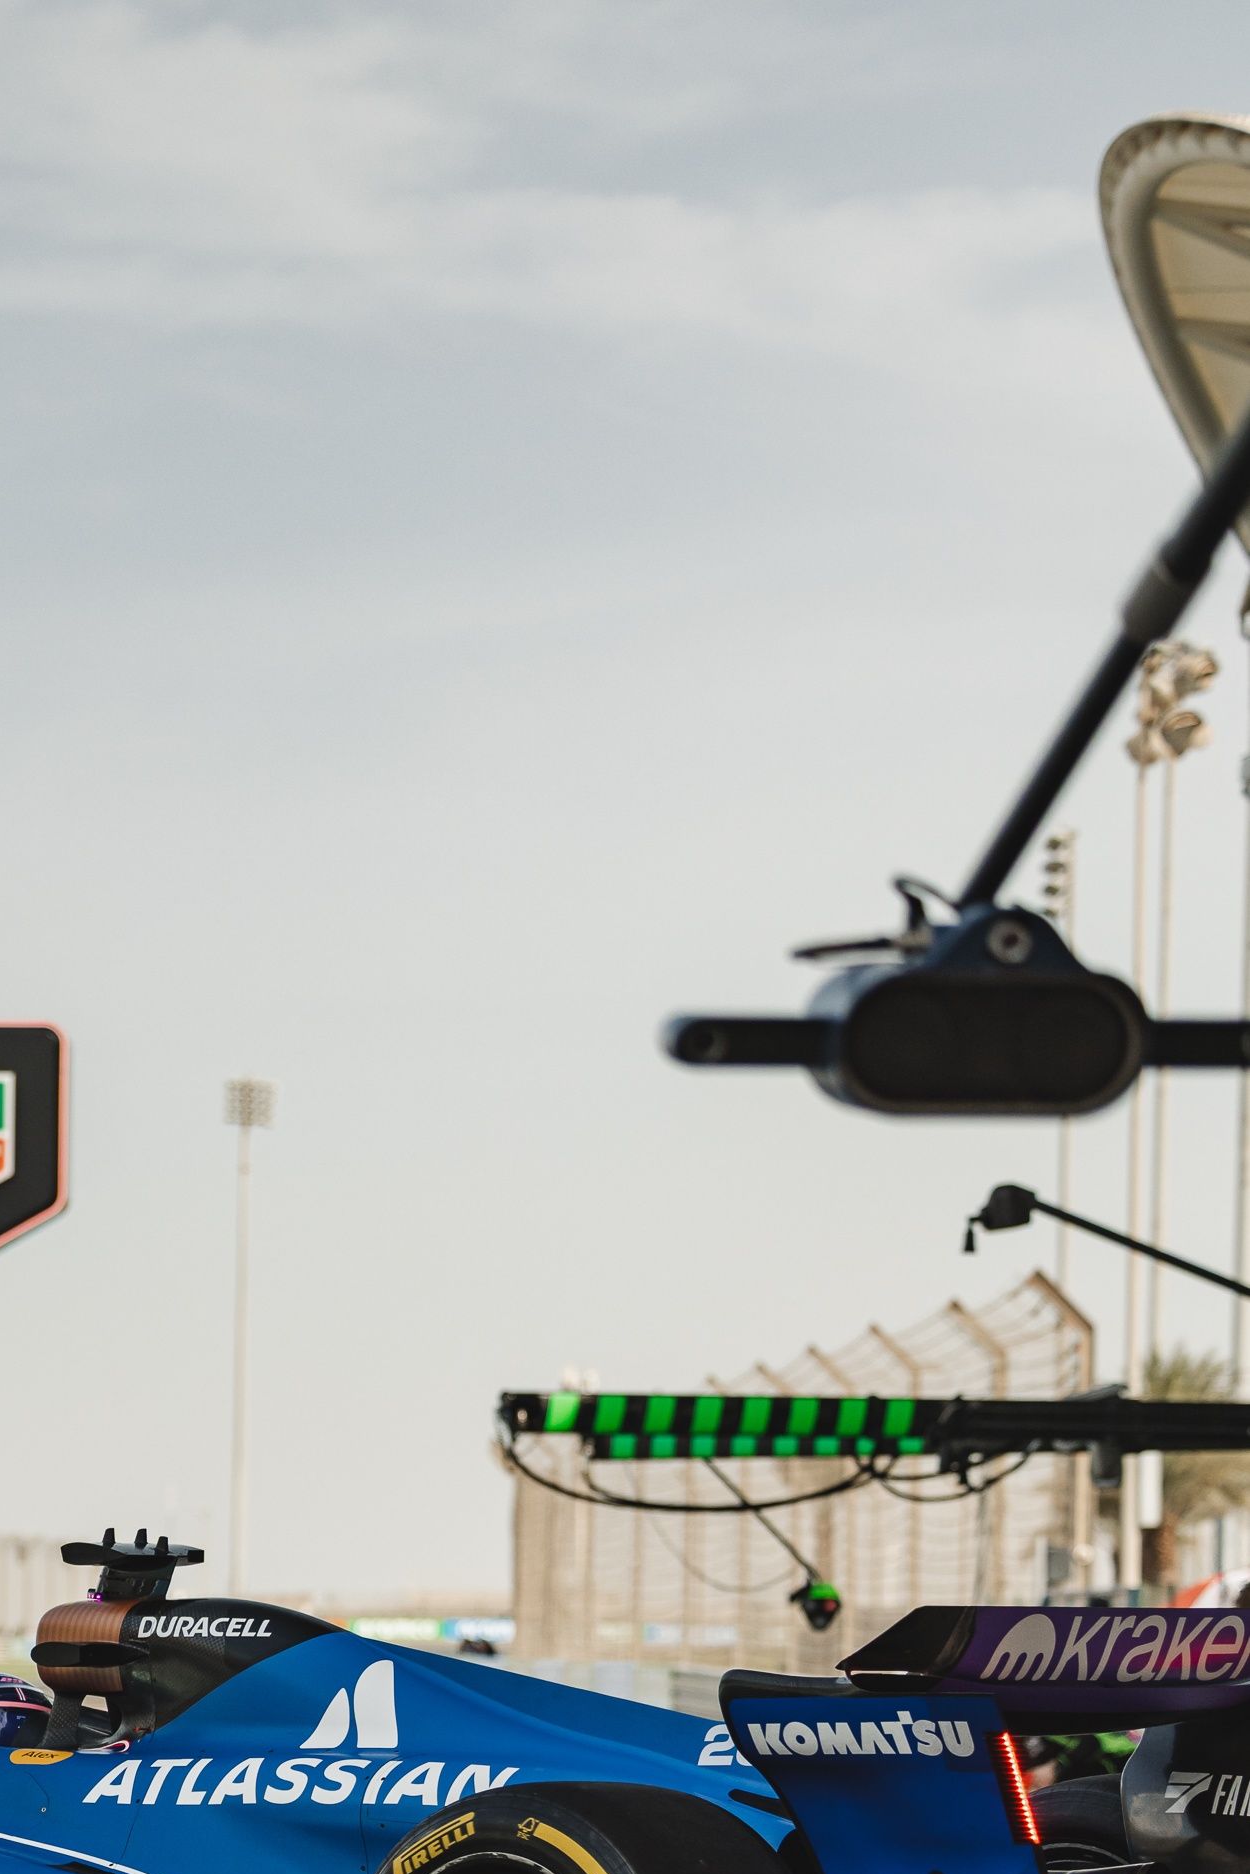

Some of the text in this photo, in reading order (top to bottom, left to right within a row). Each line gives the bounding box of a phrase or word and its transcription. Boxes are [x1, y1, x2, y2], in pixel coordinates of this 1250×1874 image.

[138, 1616, 272, 1638] DURACELL
[747, 1710, 975, 1757] KOMATSU
[21, 1750, 59, 1759] Alex
